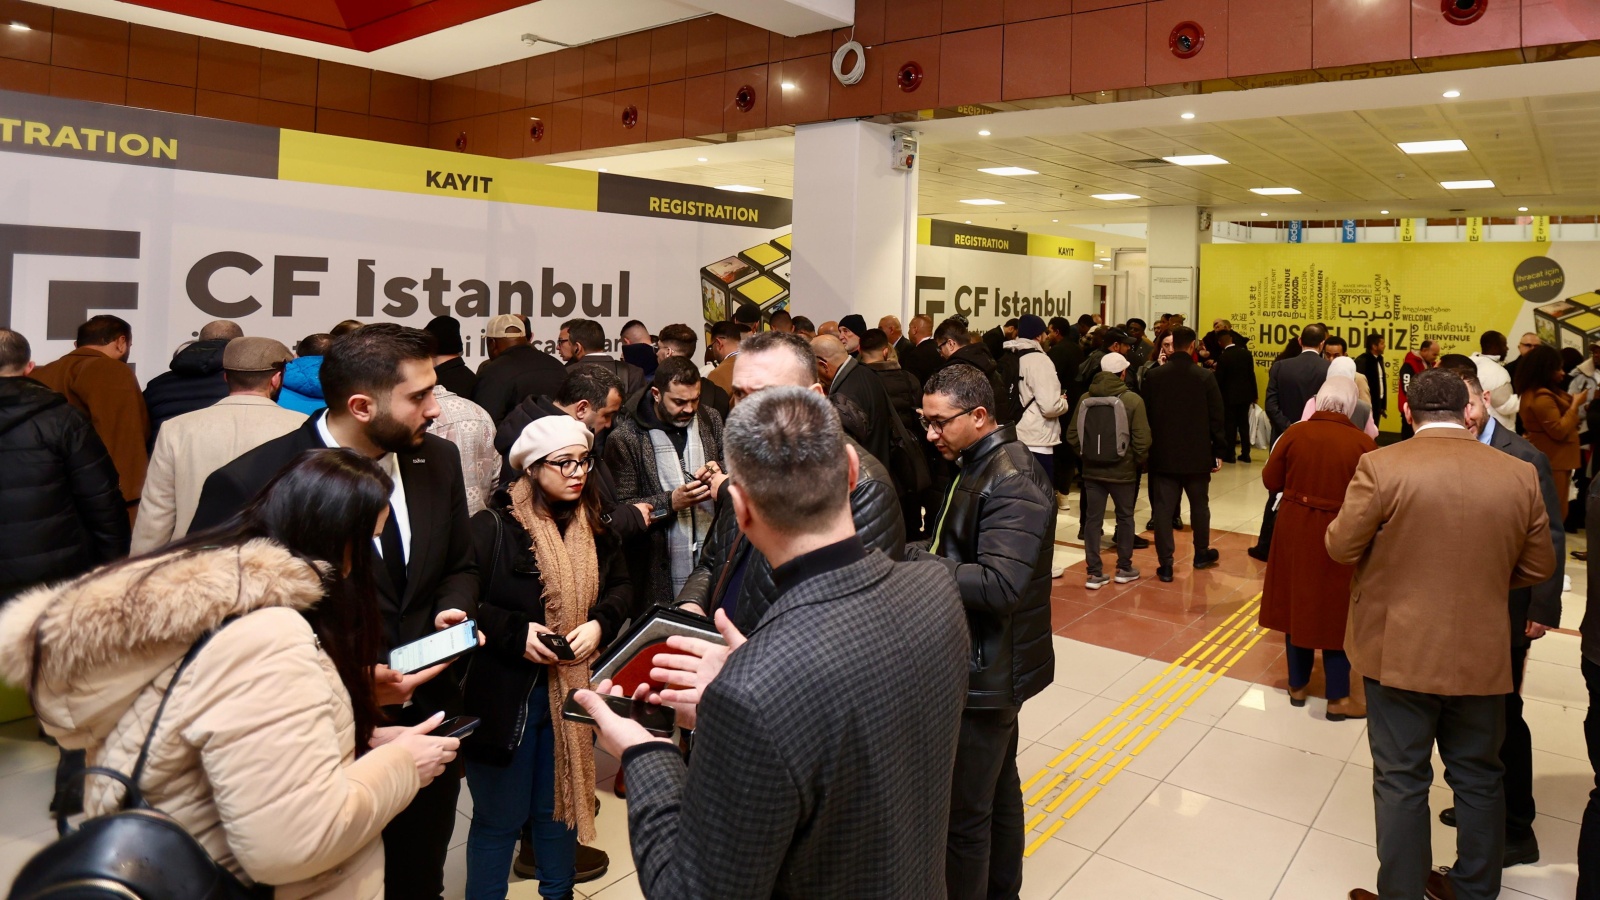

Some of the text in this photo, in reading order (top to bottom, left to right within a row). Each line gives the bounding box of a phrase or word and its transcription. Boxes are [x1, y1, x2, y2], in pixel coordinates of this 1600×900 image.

[426, 170, 493, 194] KAYIT
[649, 196, 759, 222] REGISTRATION
[954, 234, 1009, 250] REGISTRATION
[1058, 246, 1074, 257] KAYIT
[185, 250, 329, 319] CF
[954, 286, 988, 317] CF
[1402, 314, 1432, 322] WELCOME
[1424, 334, 1471, 342] BIENVENUE
